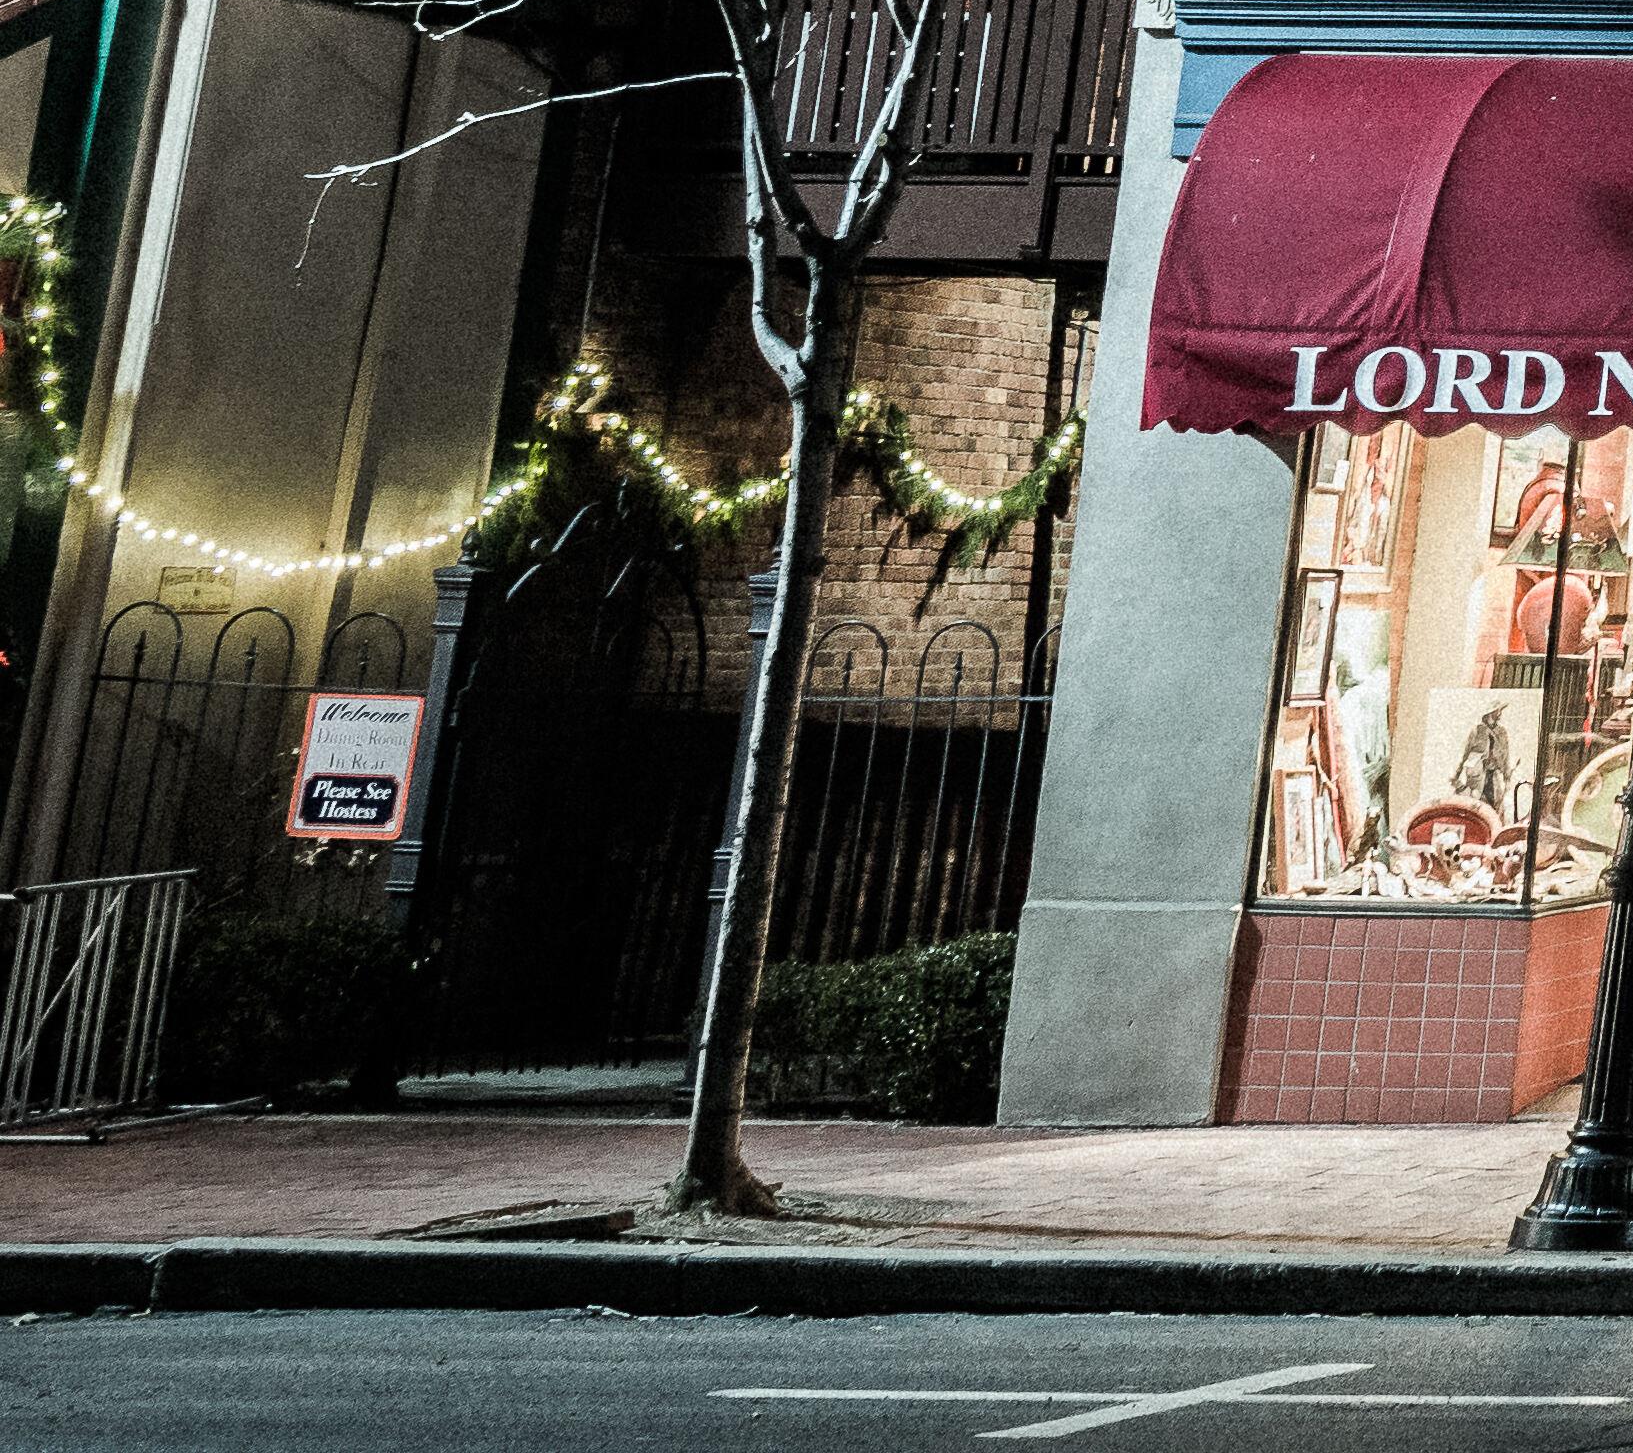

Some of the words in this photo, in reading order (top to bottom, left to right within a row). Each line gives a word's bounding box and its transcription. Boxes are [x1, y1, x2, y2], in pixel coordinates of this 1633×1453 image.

[1284, 345, 1567, 415] LORD
[320, 702, 411, 725] Welcome
[312, 780, 362, 799] Please
[363, 782, 393, 801] See
[318, 801, 379, 820] Hostess
